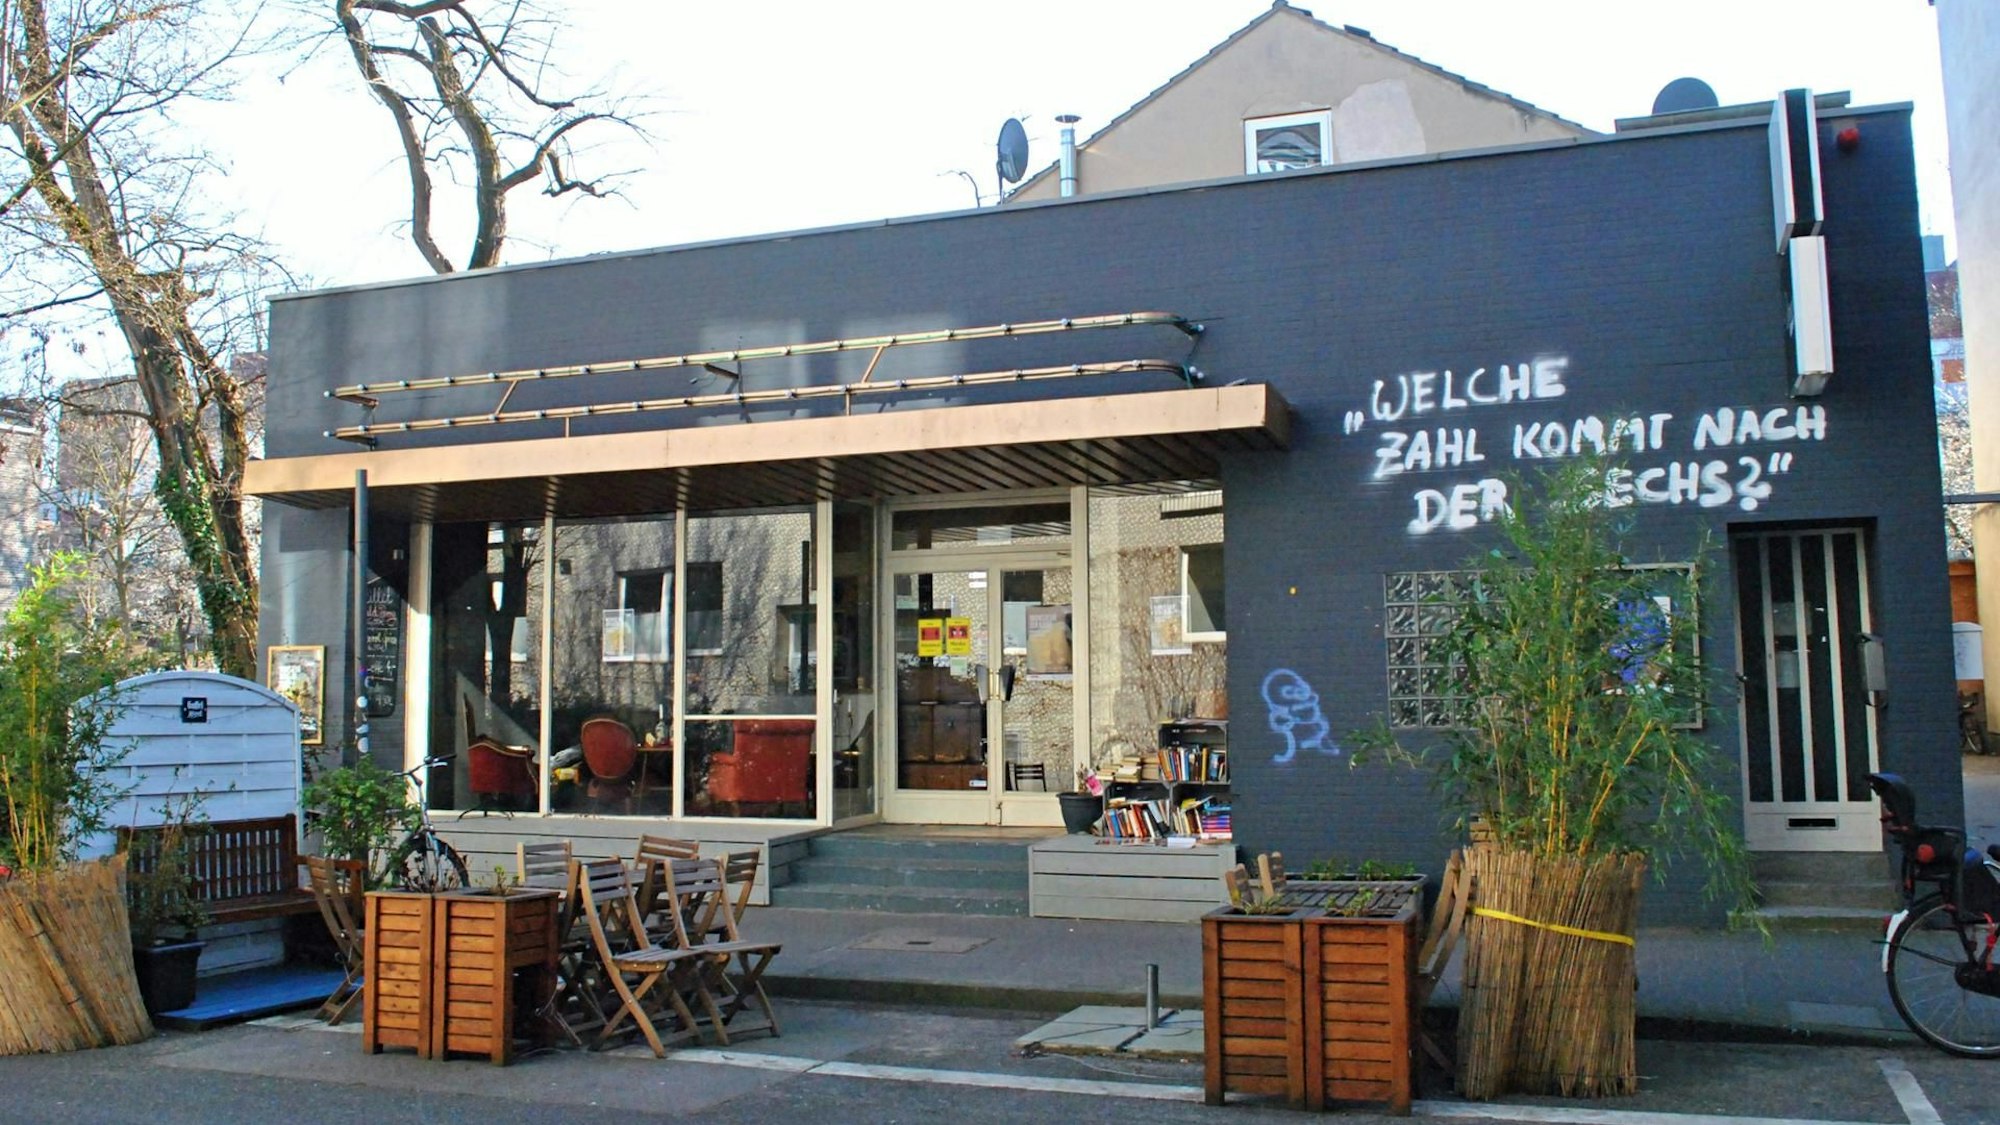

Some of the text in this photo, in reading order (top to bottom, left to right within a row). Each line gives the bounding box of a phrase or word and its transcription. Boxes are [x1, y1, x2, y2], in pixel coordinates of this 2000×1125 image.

[1374, 405, 1826, 479] ZAHL KOMMT NACH
[1407, 478, 1516, 534] DER
